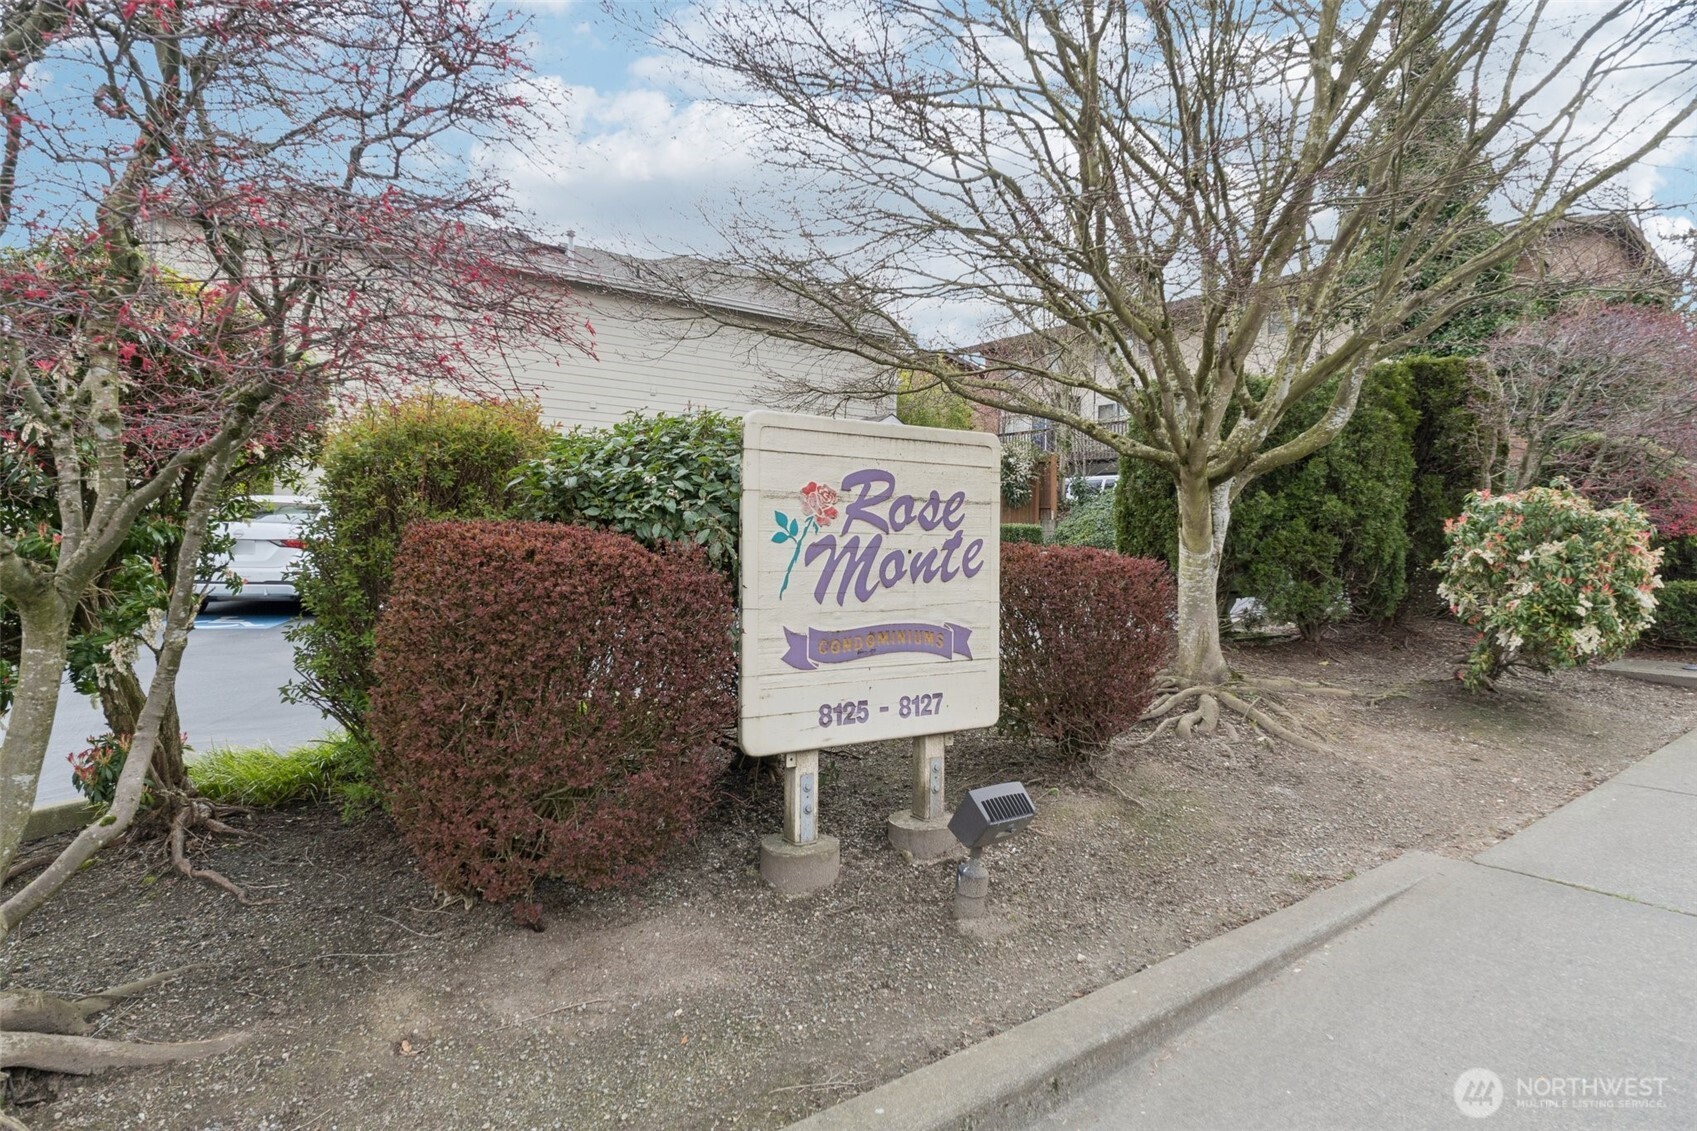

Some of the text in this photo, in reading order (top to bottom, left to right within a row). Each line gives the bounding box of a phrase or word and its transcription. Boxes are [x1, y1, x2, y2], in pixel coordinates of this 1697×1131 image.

[841, 468, 966, 536] Rose
[805, 530, 984, 606] Monte
[818, 631, 944, 655] CONDOMINIUMS
[818, 700, 869, 728] 8125
[899, 692, 943, 719] 8127
